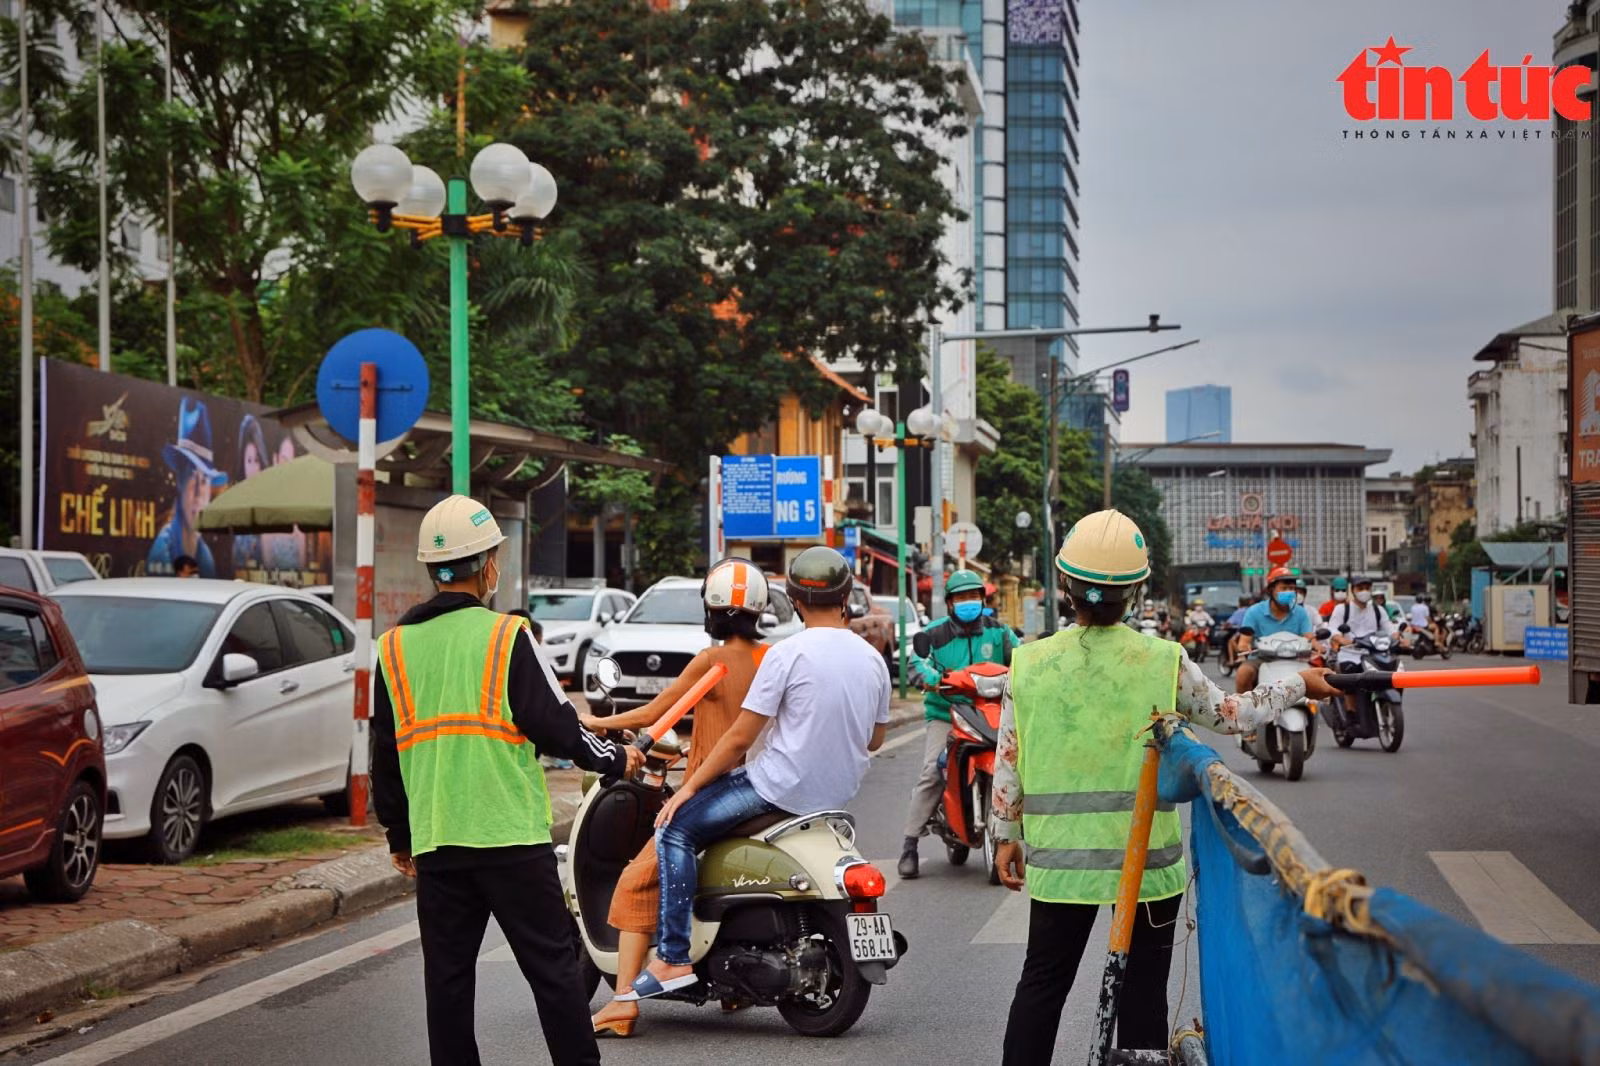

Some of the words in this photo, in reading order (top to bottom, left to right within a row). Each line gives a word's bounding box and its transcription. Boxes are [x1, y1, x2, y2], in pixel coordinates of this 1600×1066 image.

[60, 483, 108, 535] CHẾ
[109, 498, 156, 539] LINH
[804, 499, 815, 522] 5
[732, 874, 771, 888] Vino
[853, 916, 887, 937] 29-AA
[853, 938, 893, 958] 568.44
